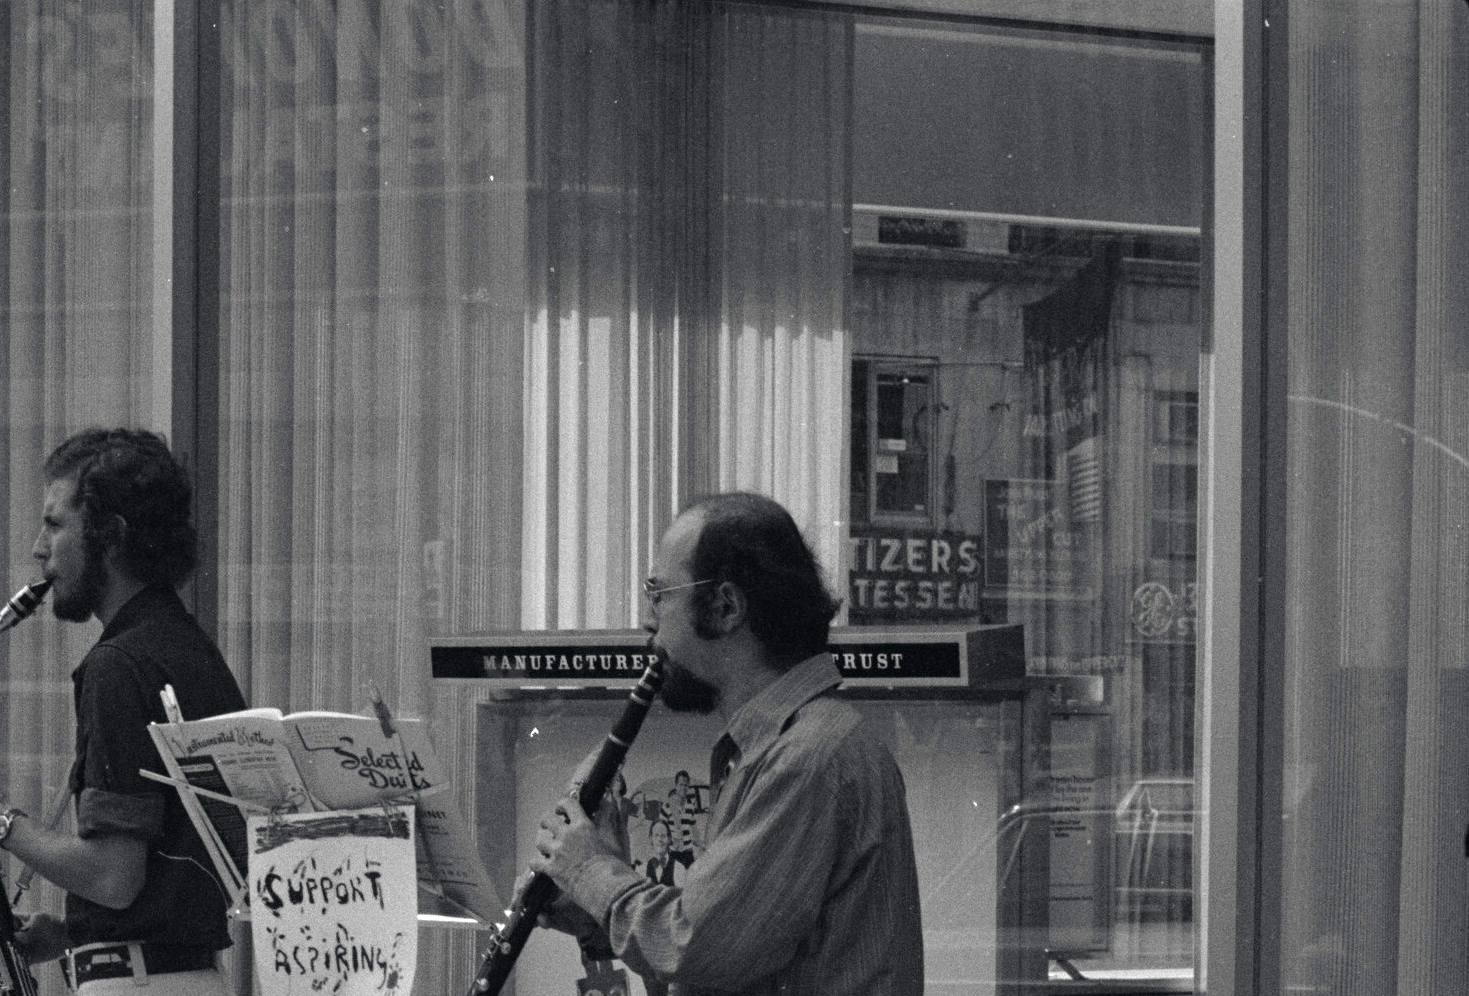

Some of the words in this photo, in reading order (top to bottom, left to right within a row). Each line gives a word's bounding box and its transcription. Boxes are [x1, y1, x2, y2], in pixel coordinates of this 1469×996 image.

[851, 578, 979, 611] TESSEN
[334, 736, 425, 773] Selectd
[262, 871, 384, 911] SUPPORT
